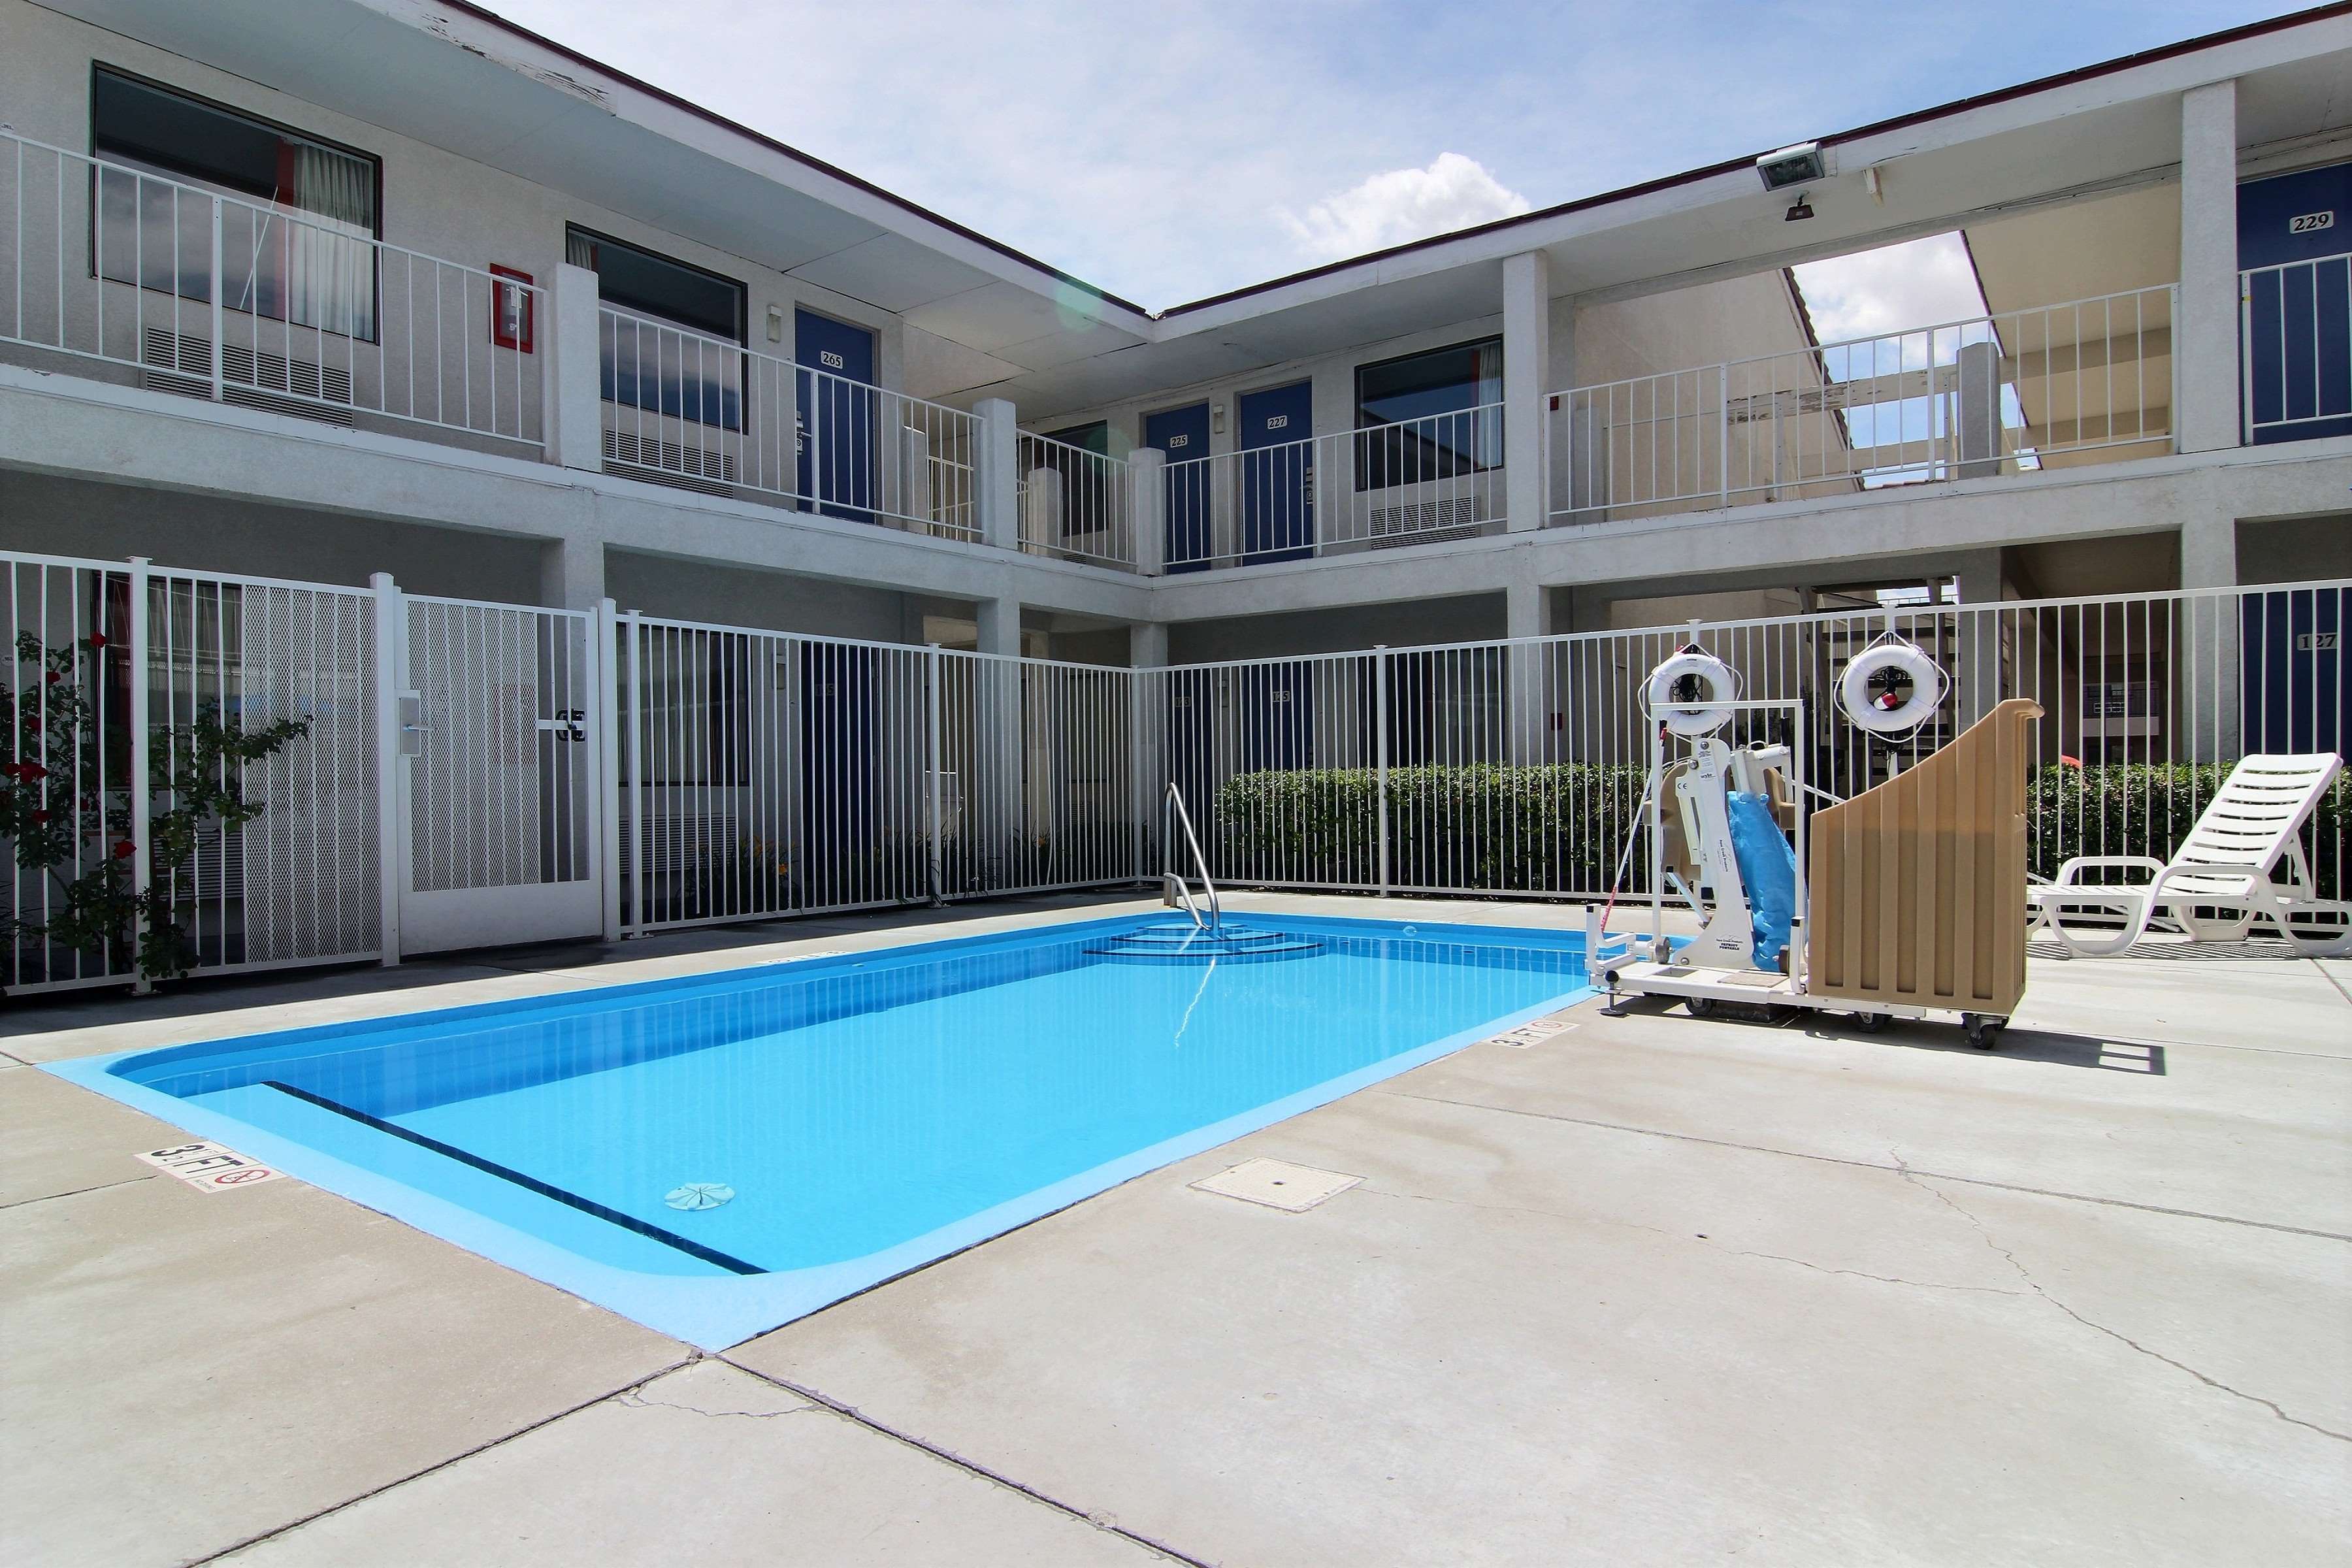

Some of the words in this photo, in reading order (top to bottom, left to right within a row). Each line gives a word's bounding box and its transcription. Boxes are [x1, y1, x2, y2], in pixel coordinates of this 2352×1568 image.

[2294, 214, 2329, 231] 229
[823, 353, 841, 367] 265
[1269, 416, 1286, 429] 227
[1171, 436, 1186, 447] 225
[2302, 634, 2337, 649] 127
[817, 685, 834, 694] 15
[1511, 1028, 1551, 1038] FT
[173, 1155, 245, 1173] FT
